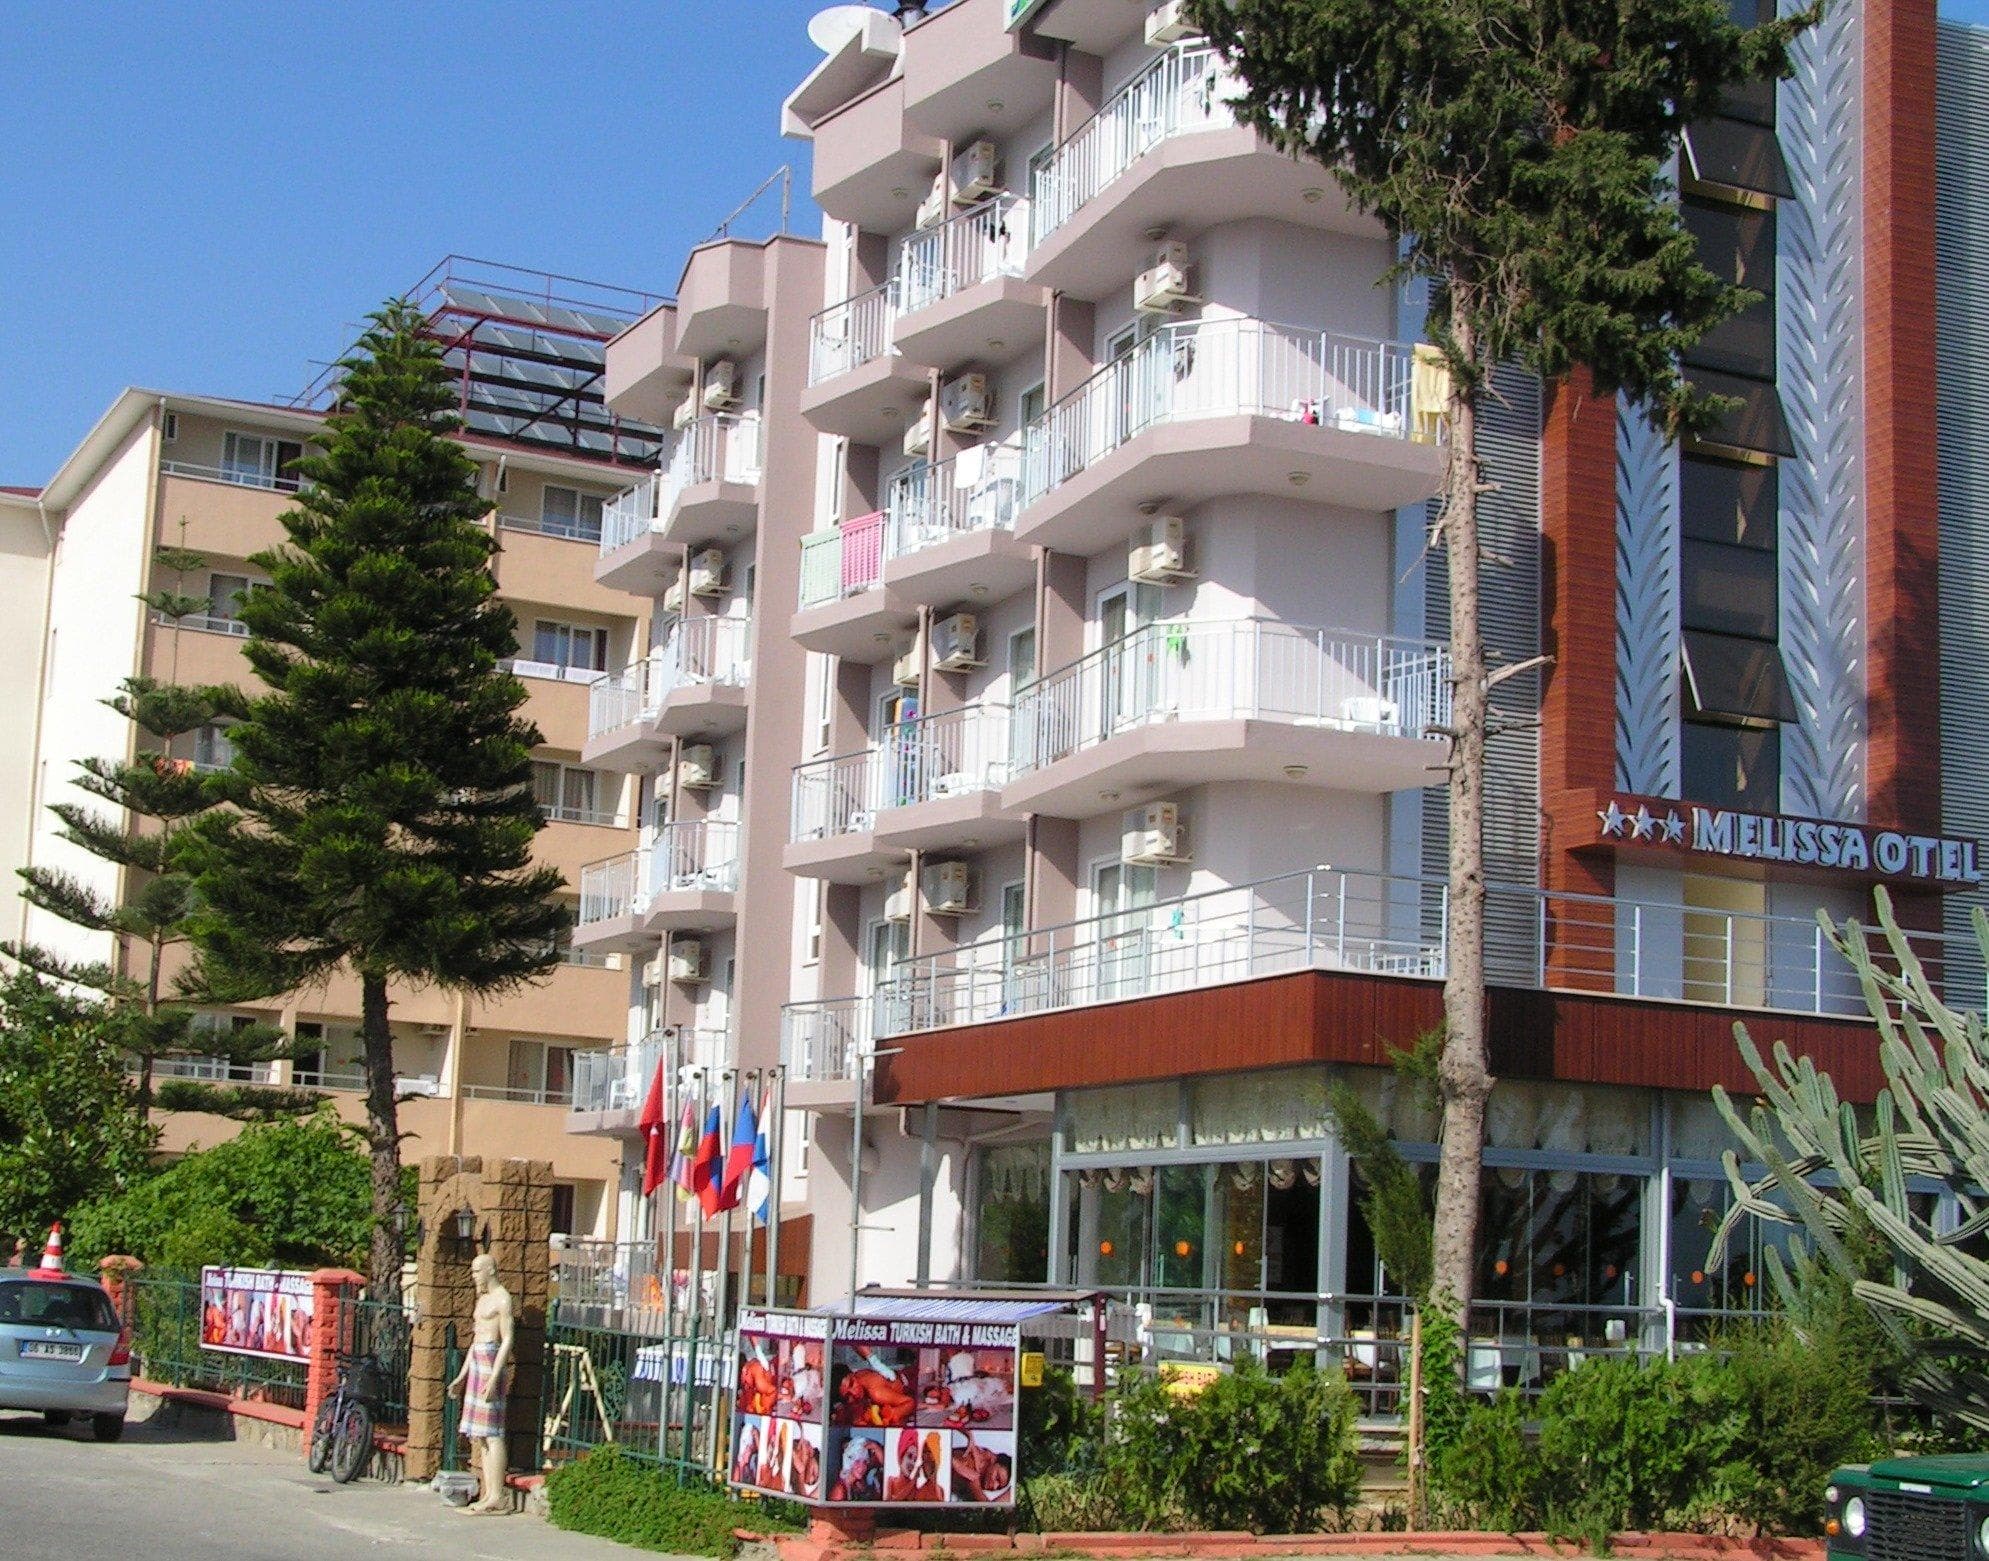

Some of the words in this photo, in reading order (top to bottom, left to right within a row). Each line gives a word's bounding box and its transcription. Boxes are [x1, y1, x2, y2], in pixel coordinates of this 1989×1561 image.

[1691, 806, 1869, 870] MELISSA
[1873, 832, 1982, 883] OTEL
[832, 1318, 887, 1340] Melissa
[889, 1322, 934, 1343] TURKISH
[934, 1324, 961, 1344] BATH
[962, 1325, 970, 1346] &
